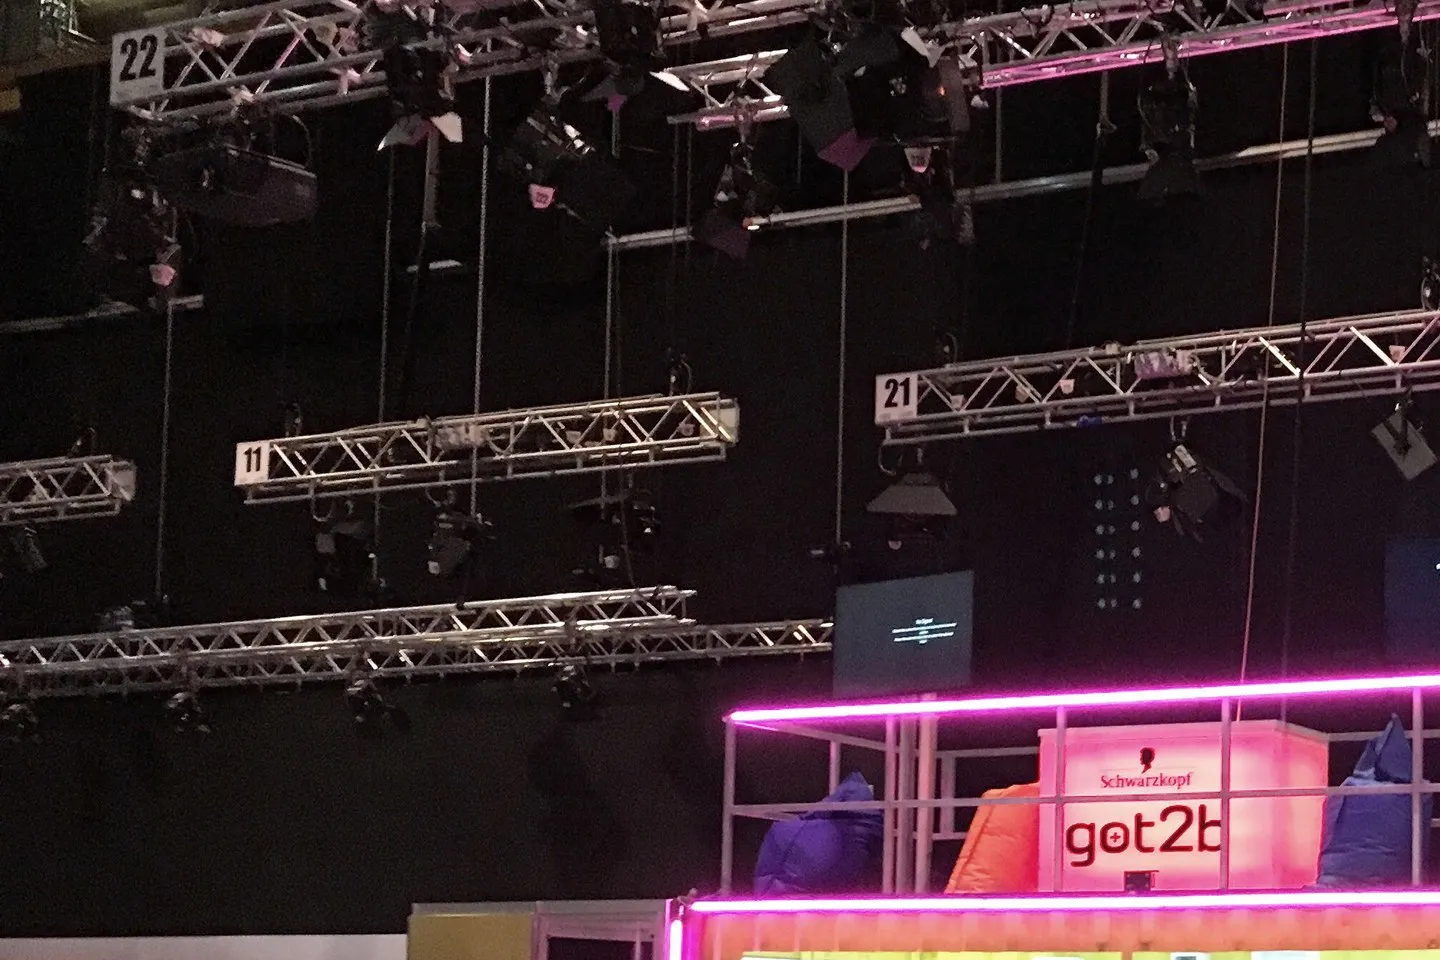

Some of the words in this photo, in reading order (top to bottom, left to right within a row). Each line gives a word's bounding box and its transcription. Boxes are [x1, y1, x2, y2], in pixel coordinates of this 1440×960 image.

[120, 34, 157, 82] 22
[884, 377, 910, 408] 21
[243, 446, 261, 472] 11
[1100, 772, 1193, 789] Schwarzkopf
[1066, 804, 1222, 867] got2b
